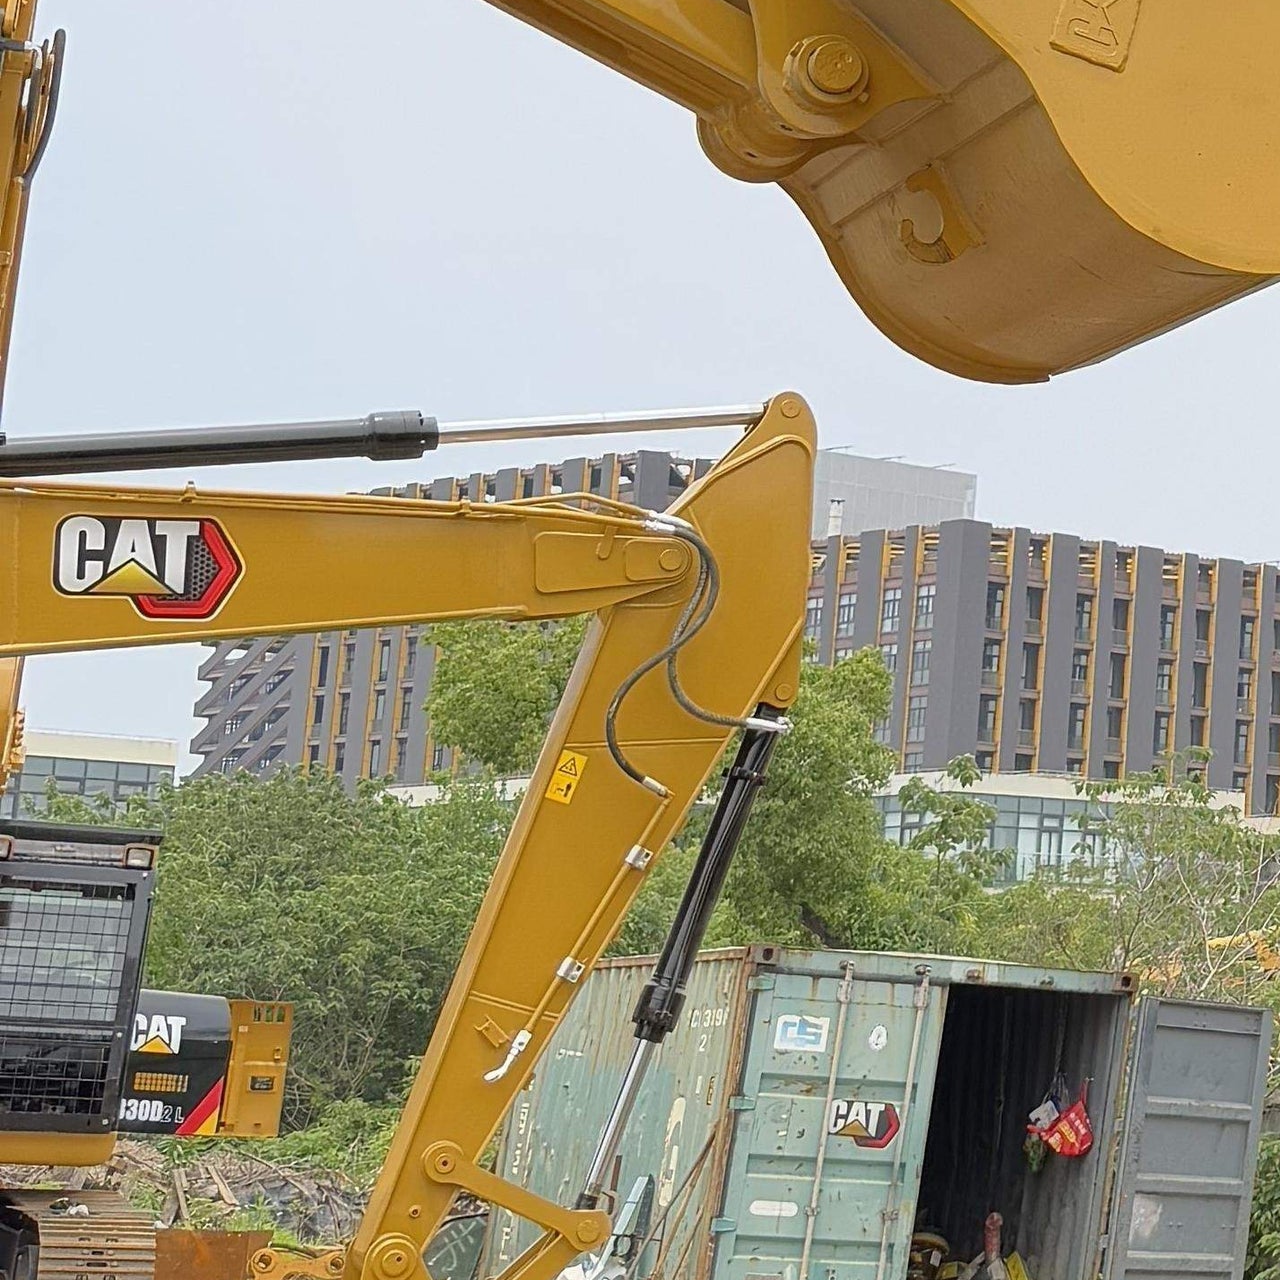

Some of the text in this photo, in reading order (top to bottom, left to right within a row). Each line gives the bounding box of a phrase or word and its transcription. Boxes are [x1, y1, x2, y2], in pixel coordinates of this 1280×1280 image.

[58, 515, 201, 595] CAT
[130, 1013, 187, 1055] CAT
[828, 1098, 886, 1139] CAT
